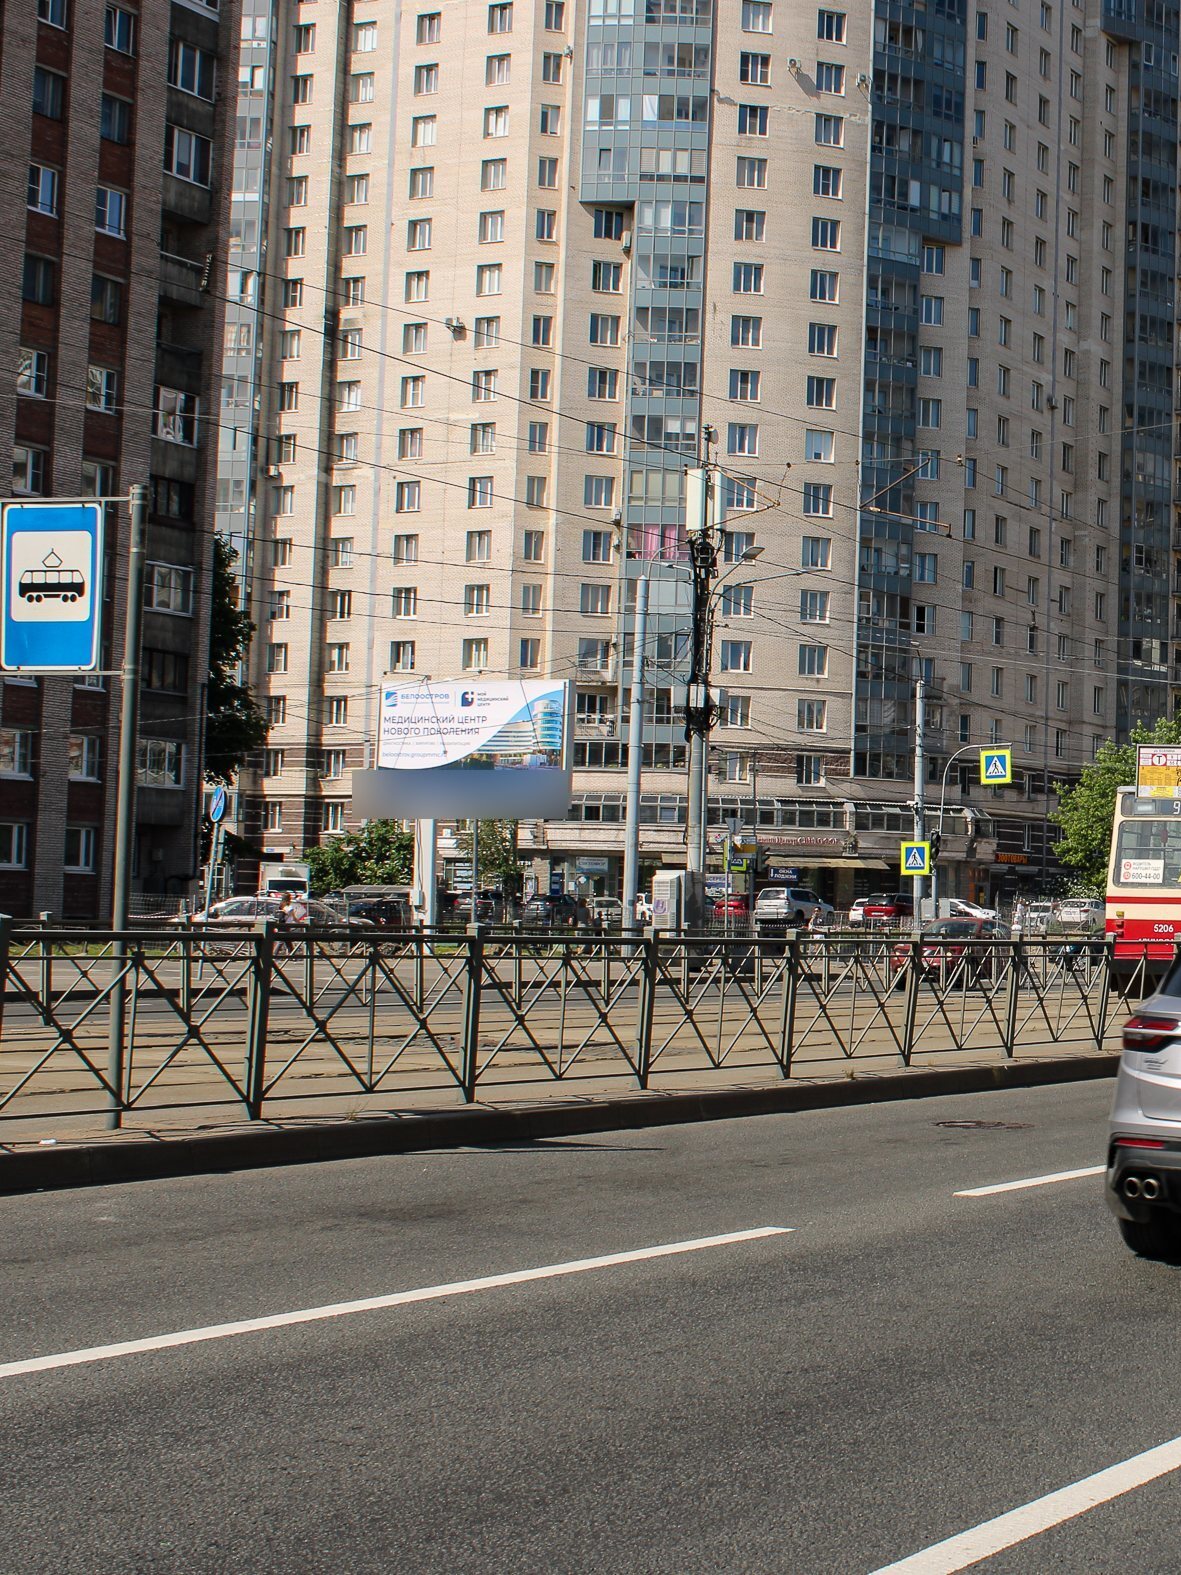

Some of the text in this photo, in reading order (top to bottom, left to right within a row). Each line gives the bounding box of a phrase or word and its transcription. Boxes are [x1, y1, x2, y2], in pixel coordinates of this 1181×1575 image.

[383, 714, 488, 726] МЕДИЦИНСКИЙ ЦЕНТР
[383, 727, 480, 736] НОВОГО ПОКОЛЕНИЯ
[1172, 800, 1181, 814] 9
[1153, 923, 1174, 933] 5206
